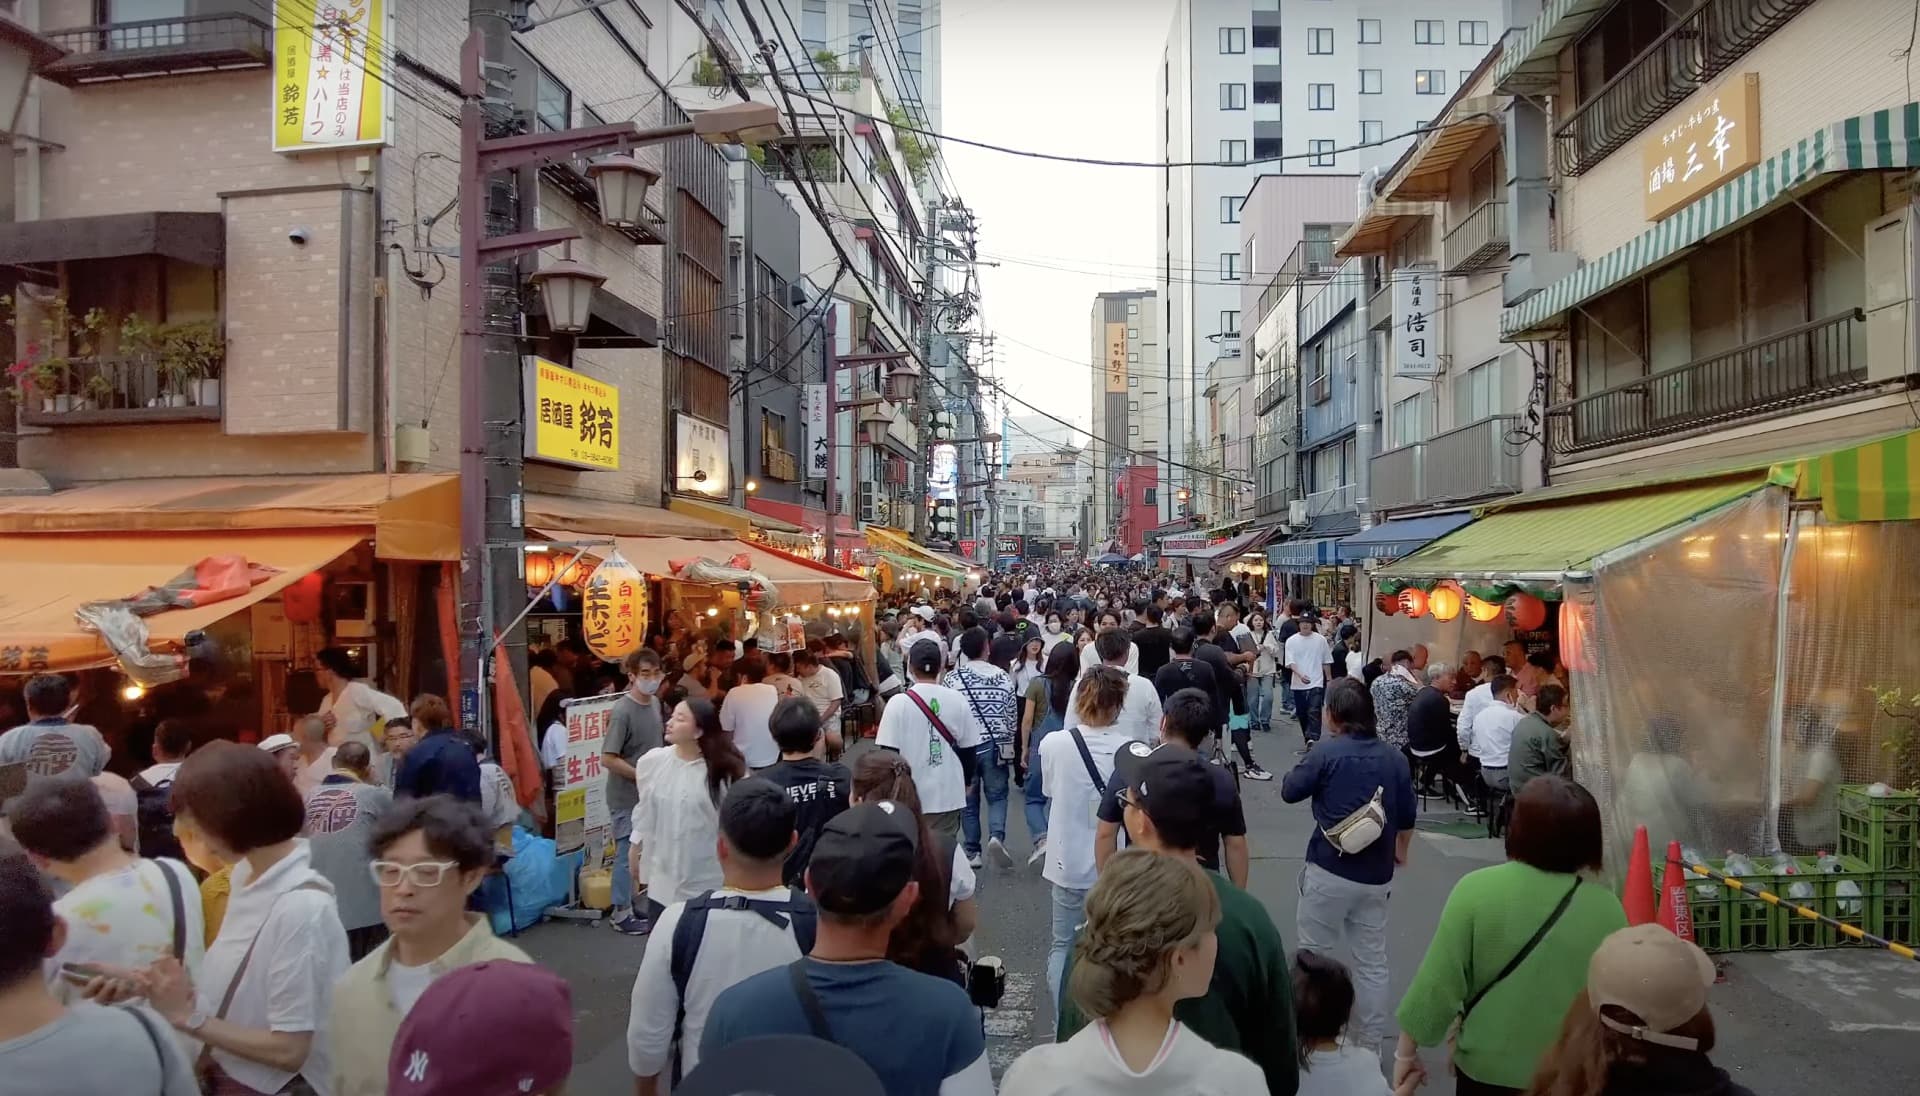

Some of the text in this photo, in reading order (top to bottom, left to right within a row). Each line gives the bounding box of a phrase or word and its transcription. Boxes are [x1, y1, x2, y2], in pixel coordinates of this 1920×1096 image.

[282, 83, 300, 126] 鈴芳
[1649, 115, 1735, 194] 酒場 三幸
[1411, 275, 1422, 307] 居酒屋
[1406, 311, 1428, 358] 浩司
[541, 398, 614, 449] 居酒屋 鈴芳
[404, 1050, 429, 1081] NY
